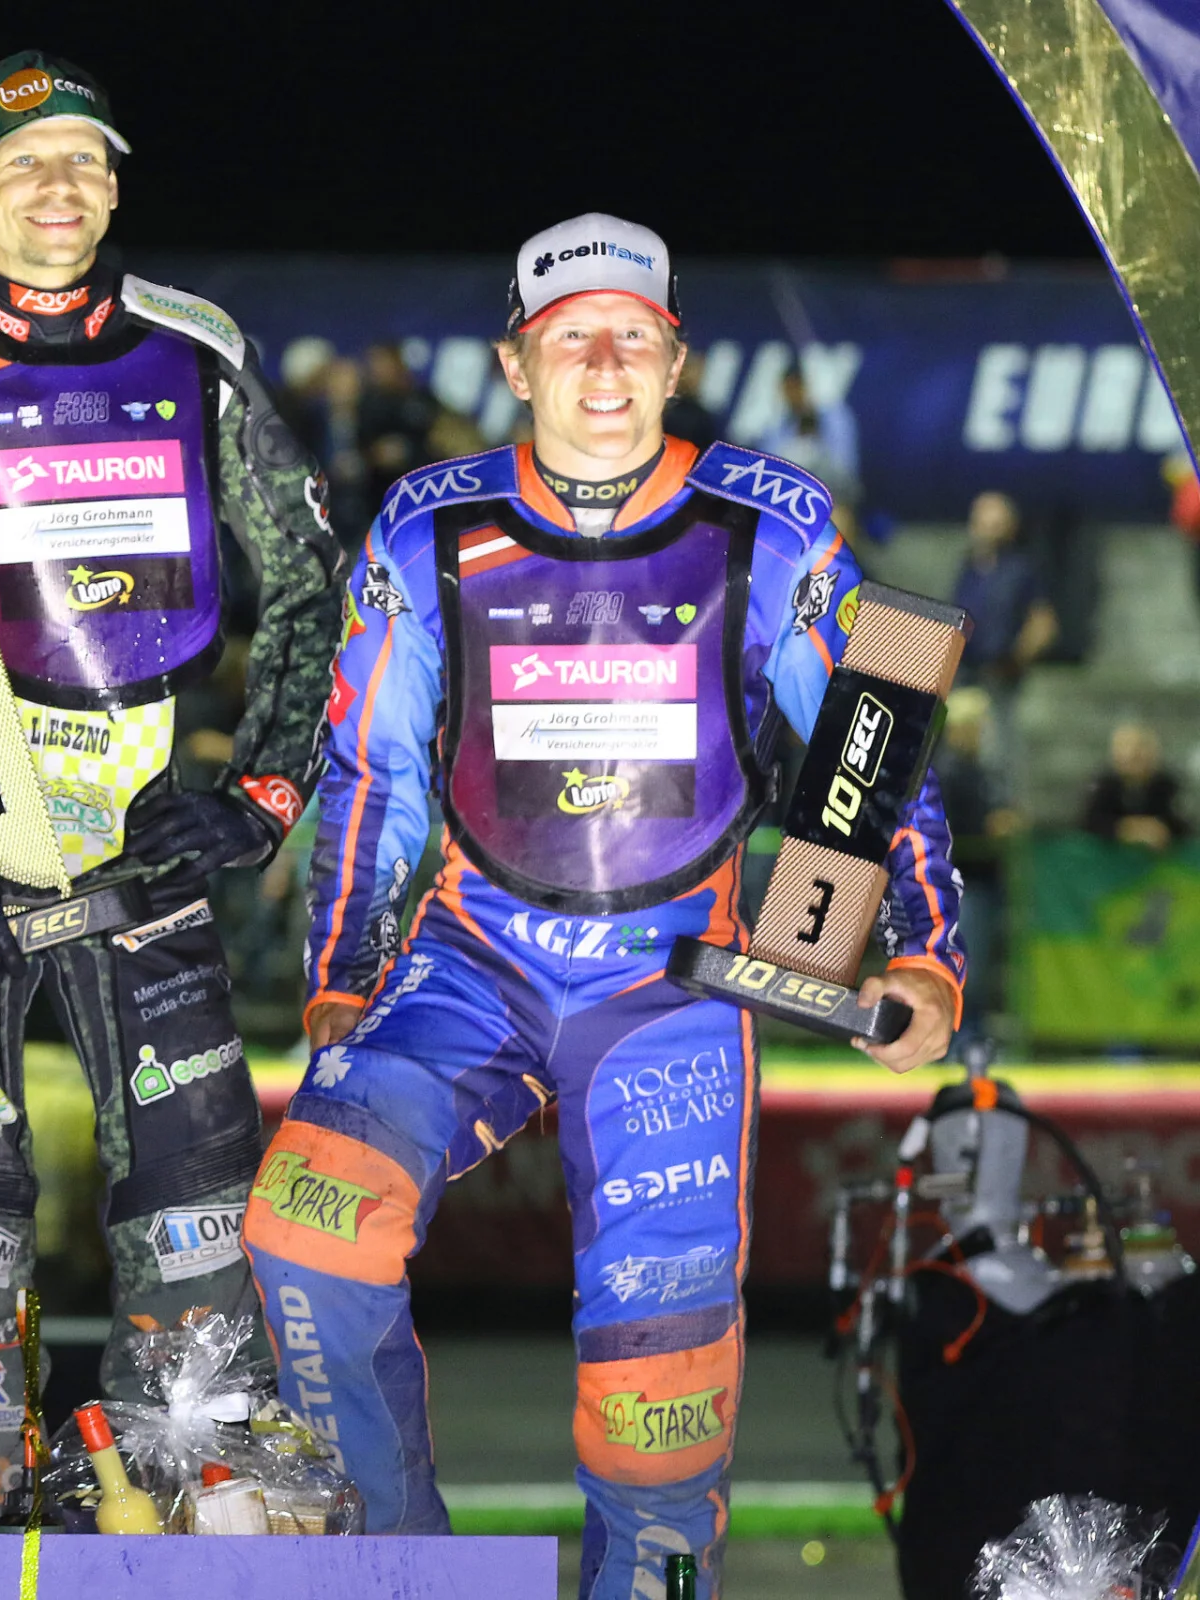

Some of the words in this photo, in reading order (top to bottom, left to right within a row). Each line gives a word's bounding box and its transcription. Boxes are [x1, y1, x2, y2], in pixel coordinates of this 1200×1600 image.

[558, 241, 653, 271] cellfast
[53, 391, 110, 426] #333
[50, 455, 166, 485] TAURON
[575, 477, 638, 500] DOM
[50, 512, 79, 526] Jörg
[83, 508, 153, 522] Grohmann
[50, 533, 155, 549] Versicherungsmakler
[566, 591, 624, 625] #129
[554, 659, 677, 685] TAURON
[549, 713, 579, 727] Jörg
[583, 711, 659, 725] Grohmann
[822, 774, 862, 837] 10
[846, 703, 882, 773] SEC
[30, 906, 82, 940] SEC
[797, 878, 835, 945] 3
[501, 911, 614, 960] AGZ
[724, 954, 778, 991] 10
[779, 977, 838, 1009] SEC
[613, 1046, 729, 1103] YOGGI
[603, 1154, 731, 1206] SOFIA
[280, 1173, 358, 1231] STARK
[167, 1214, 243, 1251] TOM
[644, 1398, 711, 1449] STARK
